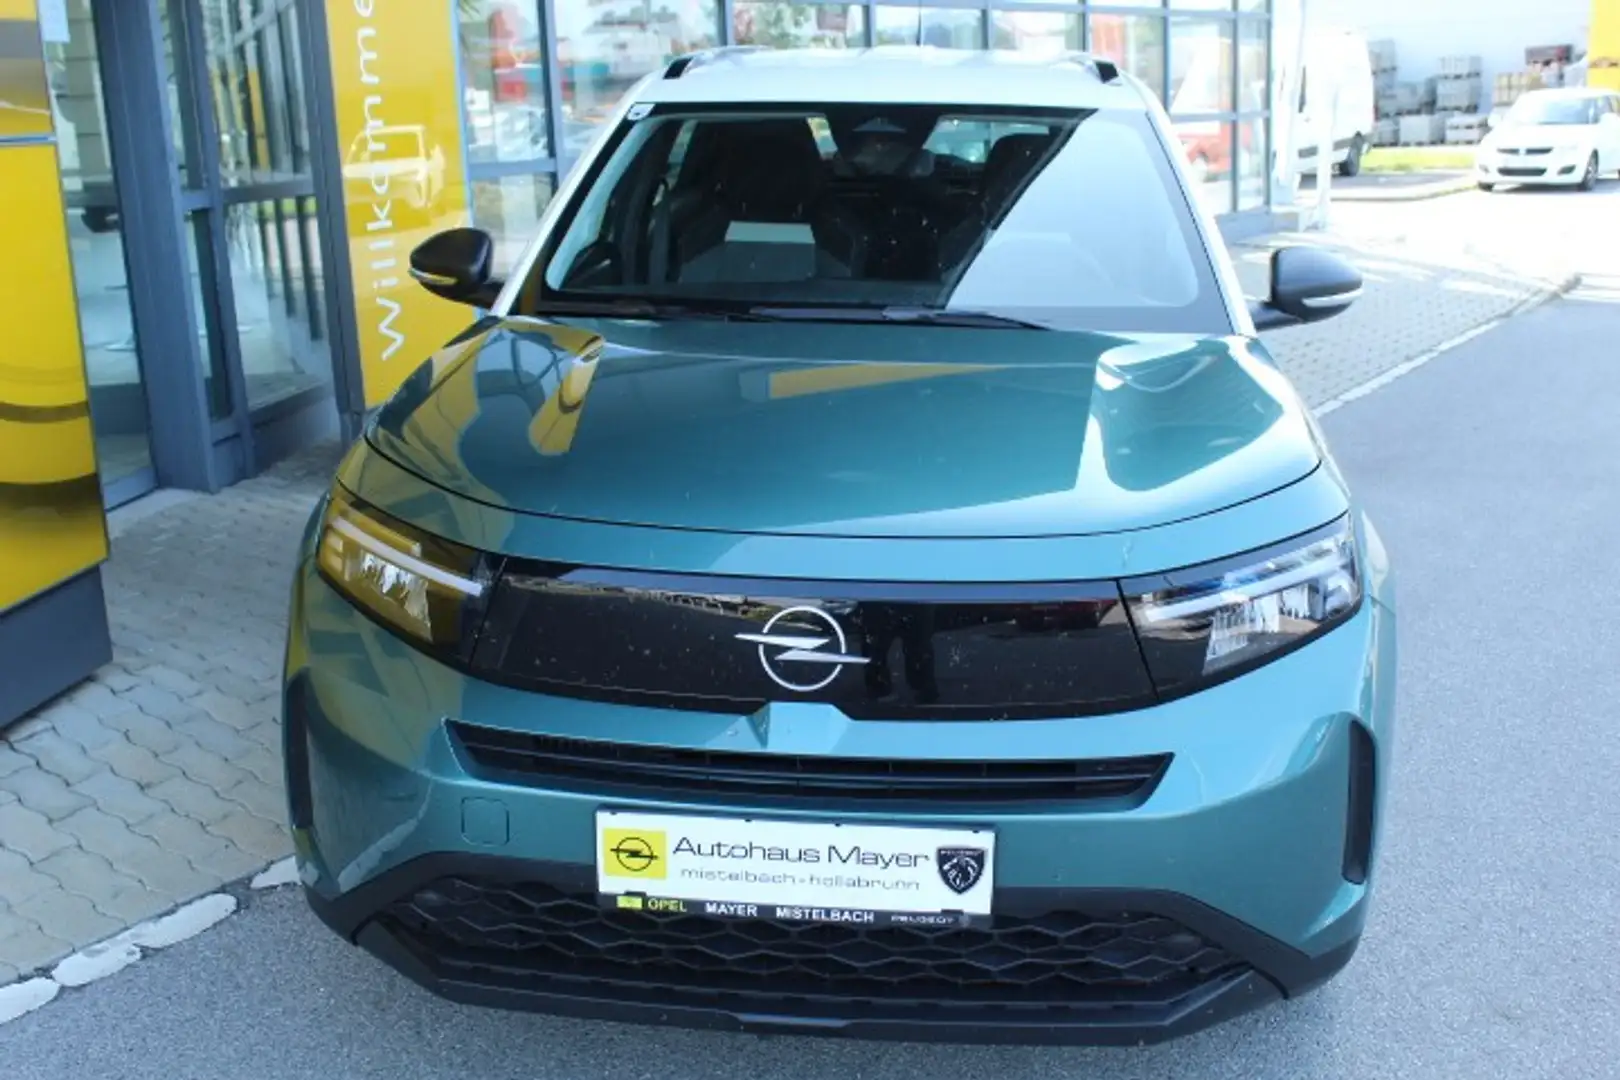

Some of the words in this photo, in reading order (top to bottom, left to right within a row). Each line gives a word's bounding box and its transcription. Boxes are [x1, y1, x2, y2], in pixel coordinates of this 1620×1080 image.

[672, 836, 821, 864] Autohaus
[827, 844, 930, 870] Mayer
[680, 867, 796, 885] mistelbach
[809, 873, 920, 891] hollabrunn
[648, 898, 687, 912] OPEL
[705, 901, 758, 917] MAYER
[775, 906, 875, 923] MISTELBACH
